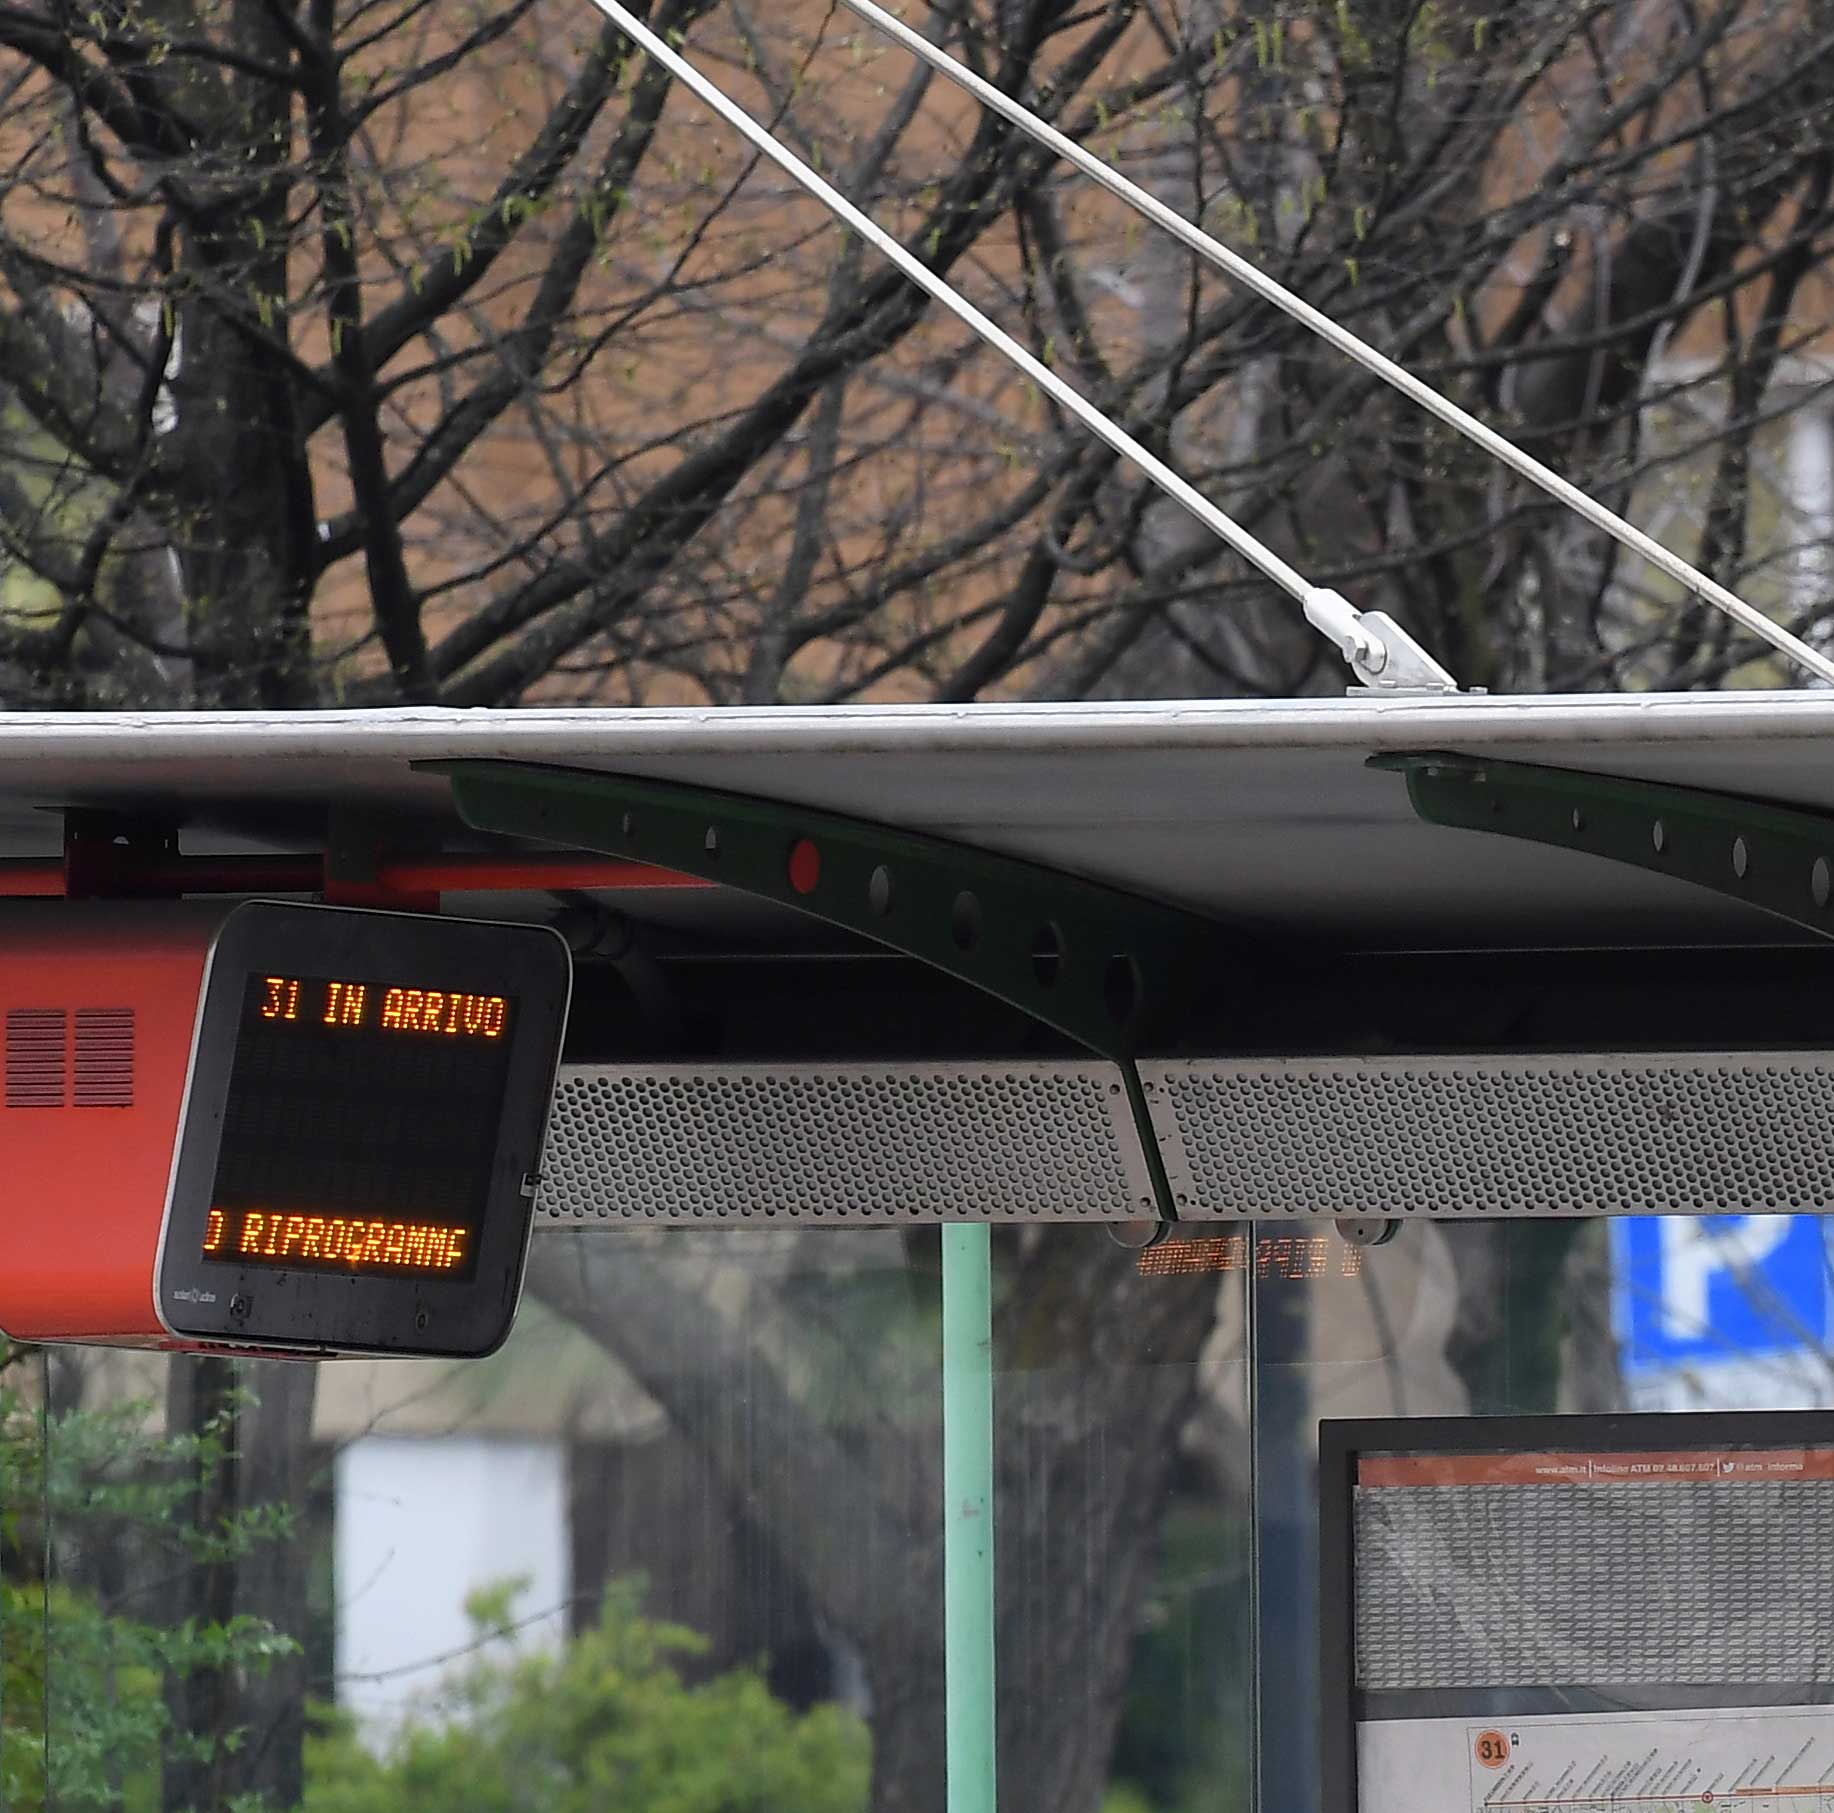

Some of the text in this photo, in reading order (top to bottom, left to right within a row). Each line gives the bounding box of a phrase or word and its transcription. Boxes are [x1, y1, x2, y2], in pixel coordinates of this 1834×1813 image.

[262, 977, 505, 1037] 31 IN ARRIVO
[1481, 1741, 1506, 1759] 31
